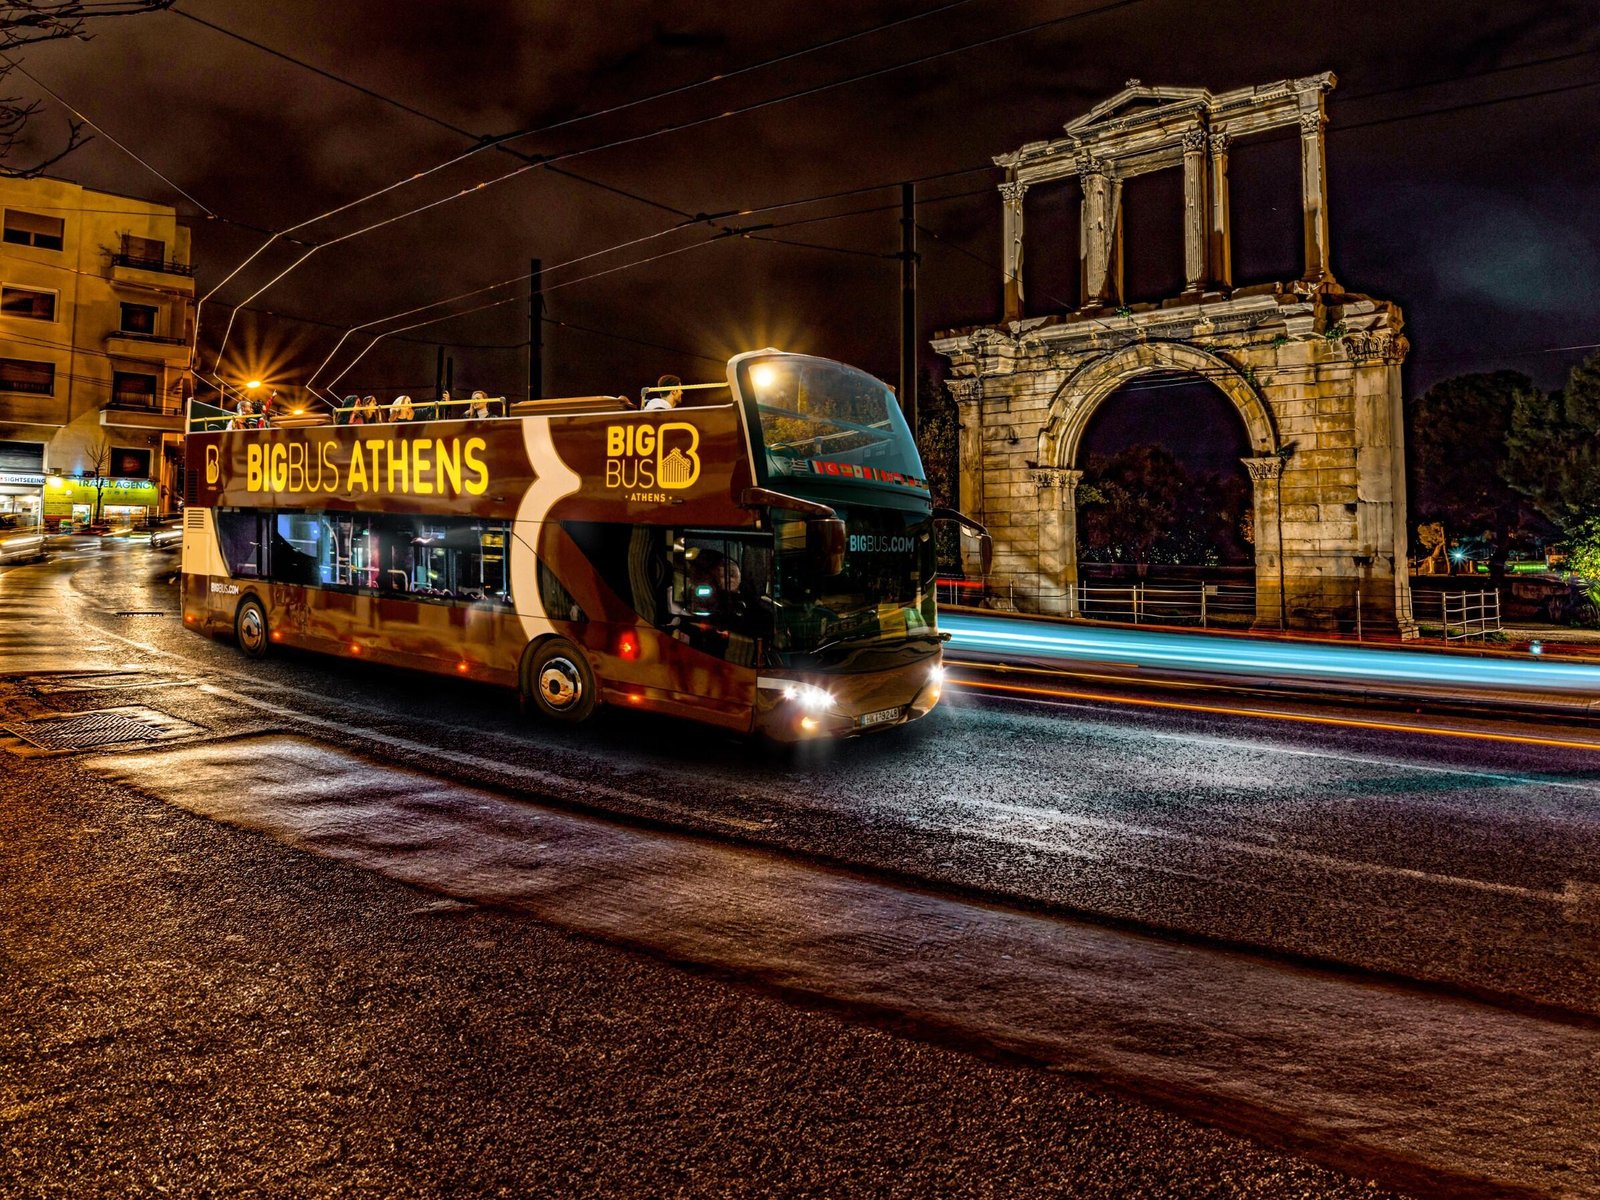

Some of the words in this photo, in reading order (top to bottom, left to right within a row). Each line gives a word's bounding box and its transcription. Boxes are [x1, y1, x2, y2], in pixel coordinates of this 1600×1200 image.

[607, 424, 655, 457] BIG
[347, 437, 489, 495] ATHENS
[606, 459, 655, 488] BUS
[4, 476, 46, 484] SIGHTSEEING
[115, 480, 156, 490] AGENCY
[631, 492, 666, 503] ATHENS
[849, 535, 914, 553] BIGBUS.COM
